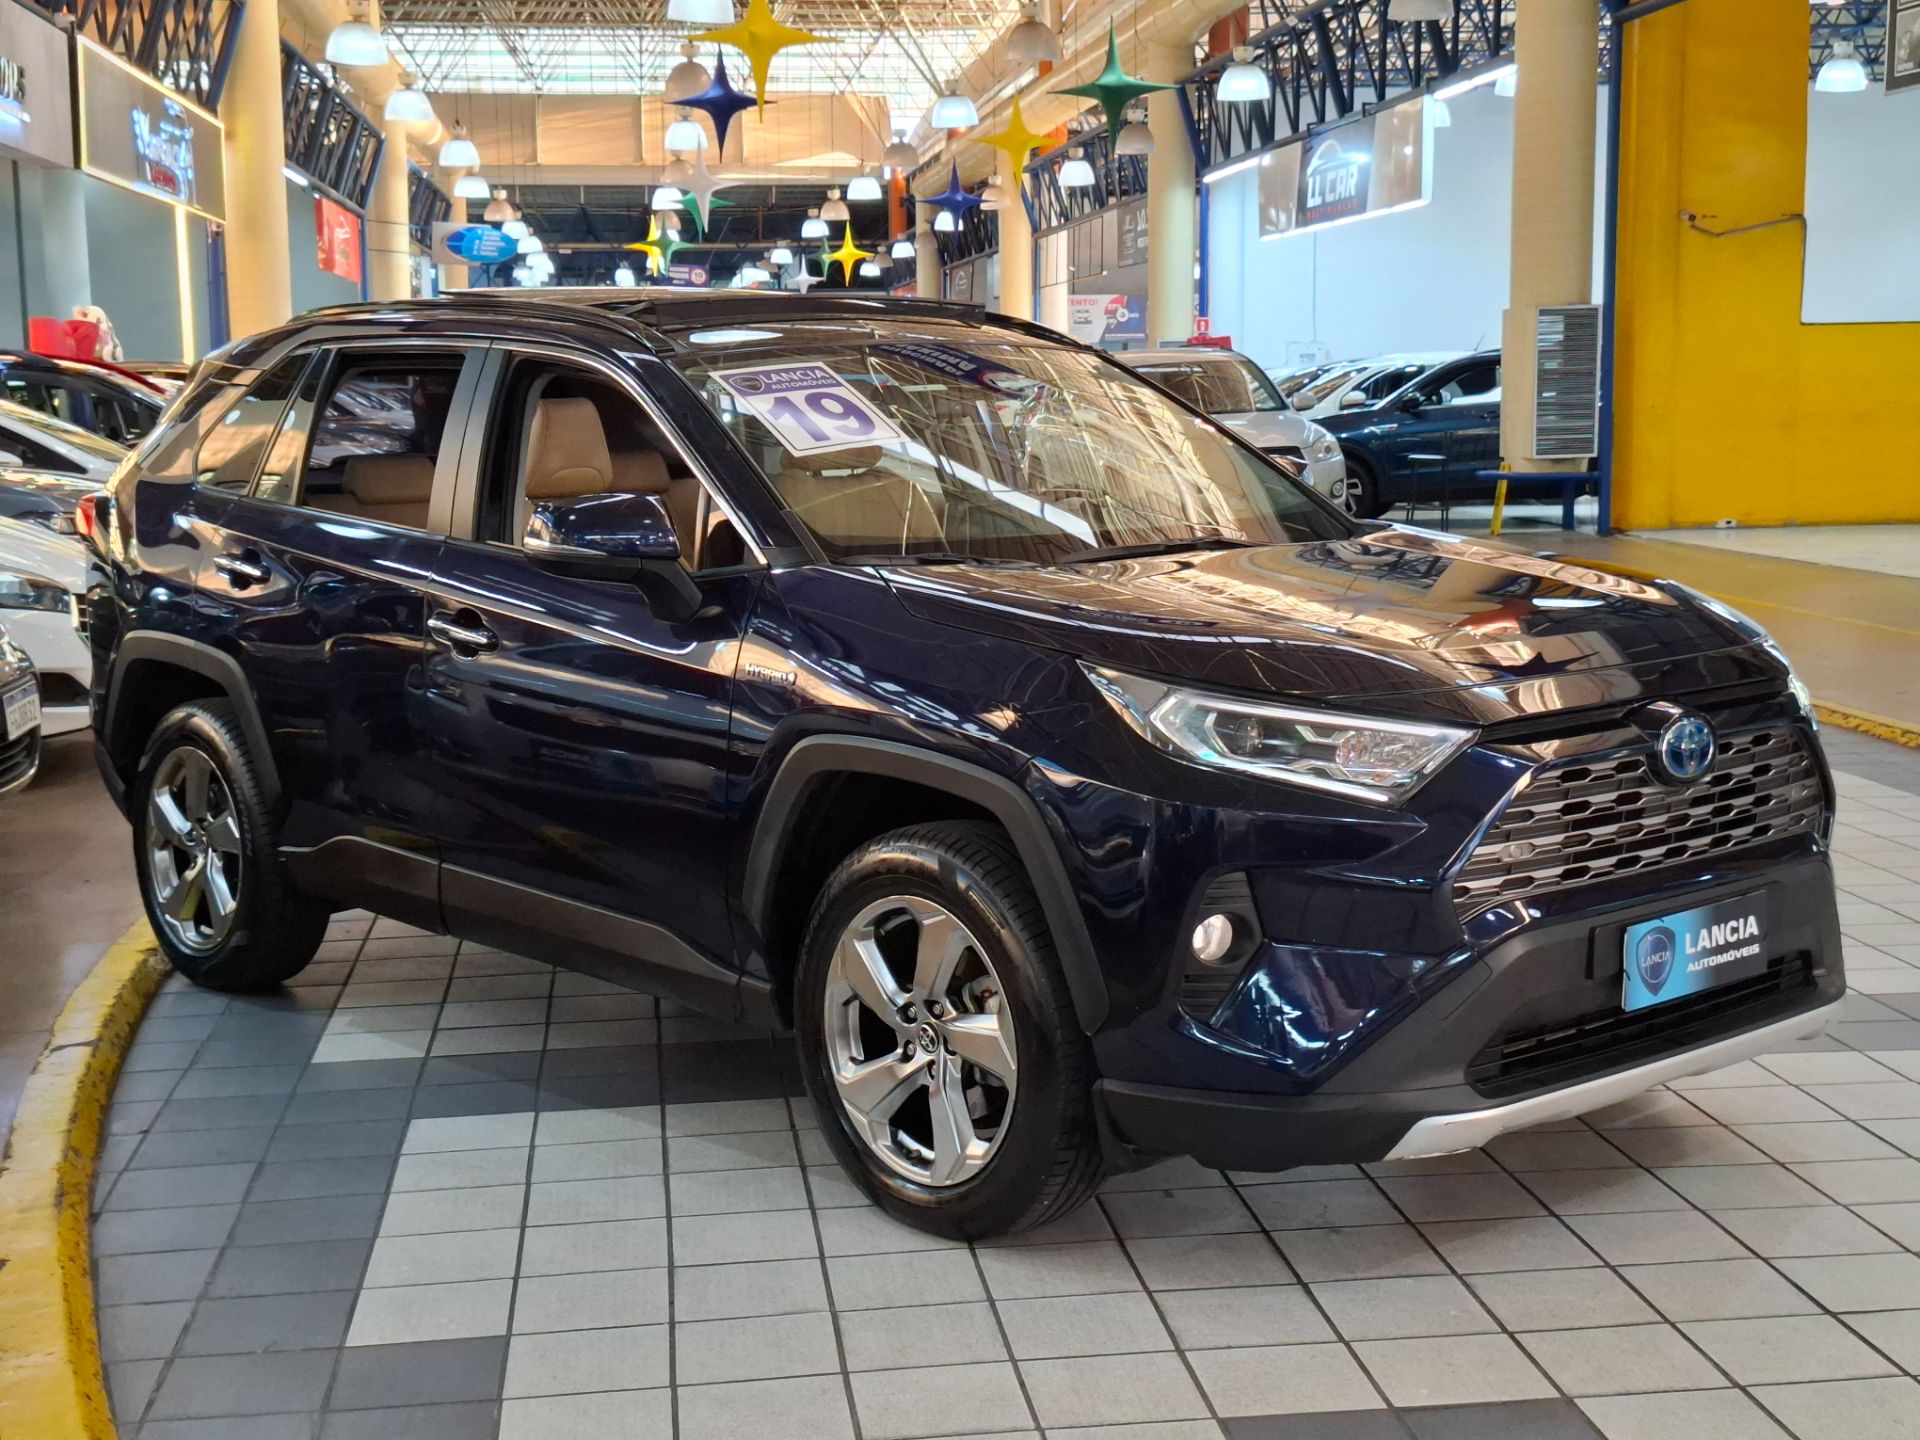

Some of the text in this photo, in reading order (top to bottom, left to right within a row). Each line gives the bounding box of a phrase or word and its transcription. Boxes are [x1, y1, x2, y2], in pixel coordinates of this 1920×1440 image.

[1325, 164, 1358, 203] CAR
[759, 368, 830, 384] LANCIA
[771, 378, 837, 390] AUTOMÓVEIS
[766, 391, 876, 442] 19
[1685, 915, 1759, 955] LANCIA
[1641, 950, 1670, 968] LANCIA
[1686, 943, 1761, 973] AUTOMÓVEIS
